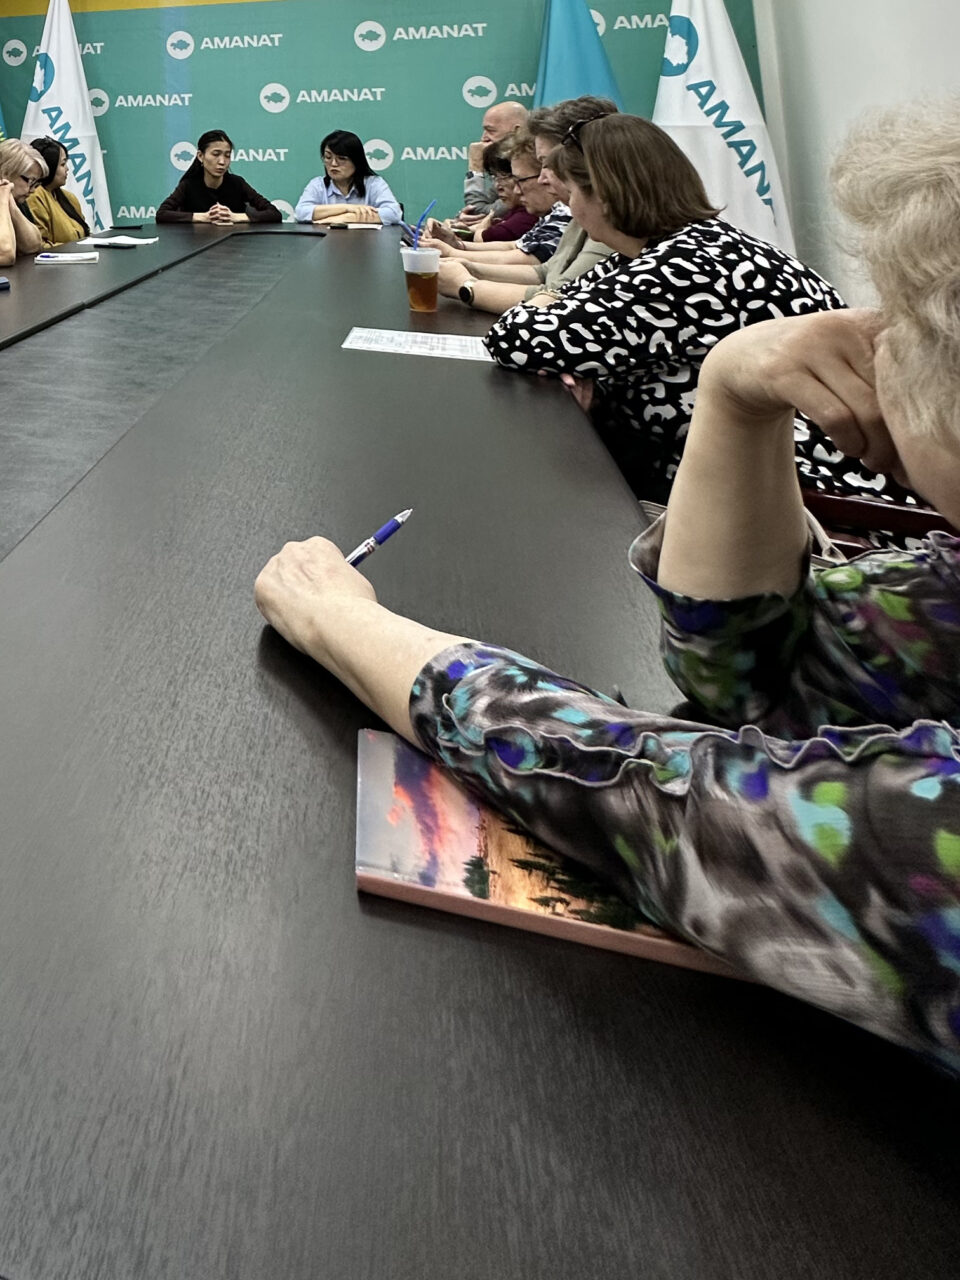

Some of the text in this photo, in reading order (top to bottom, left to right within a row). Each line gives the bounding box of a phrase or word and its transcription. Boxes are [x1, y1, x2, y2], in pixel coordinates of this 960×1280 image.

[613, 14, 670, 30] AMA
[393, 23, 488, 41] AMANAT
[200, 33, 283, 50] AMANAT
[32, 42, 104, 57] AAT
[115, 93, 193, 107] AMANAT
[296, 87, 386, 103] AMANAT
[231, 148, 289, 162] ANAT
[400, 146, 467, 161] AMAN
[686, 80, 777, 226] AMAN
[117, 205, 157, 219] AMA
